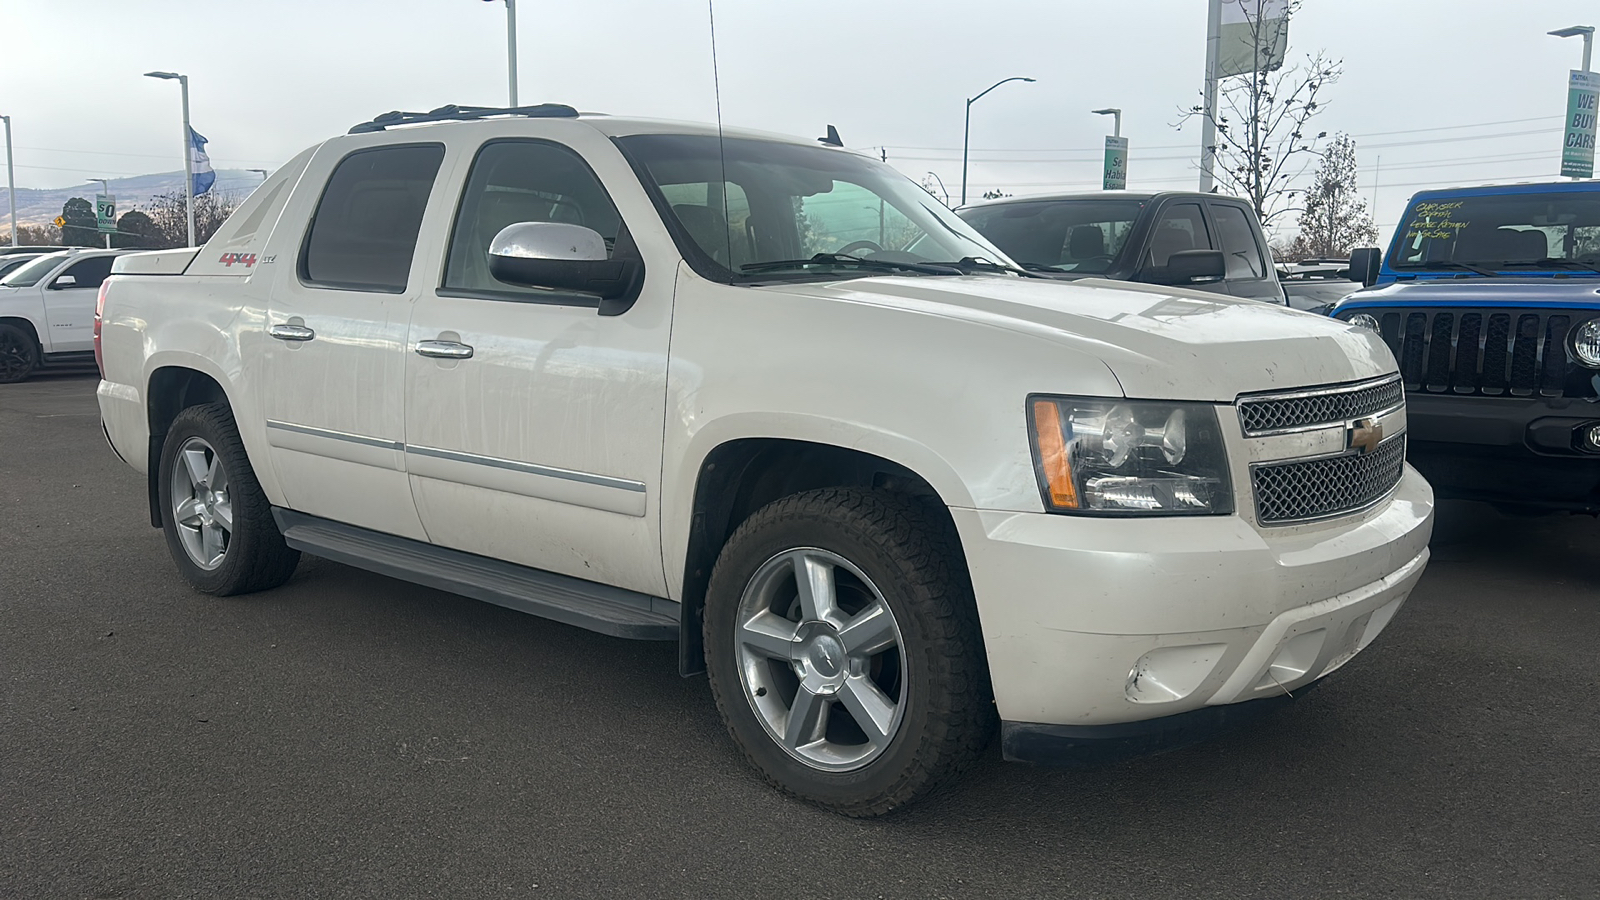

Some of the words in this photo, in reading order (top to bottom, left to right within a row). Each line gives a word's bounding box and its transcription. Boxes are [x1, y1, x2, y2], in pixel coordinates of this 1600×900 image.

[1577, 93, 1595, 110] WE
[1571, 113, 1596, 129] BUY
[1566, 132, 1596, 149] CARS
[1112, 156, 1123, 168] Se
[1105, 169, 1126, 181] Habla
[98, 203, 115, 218] $0
